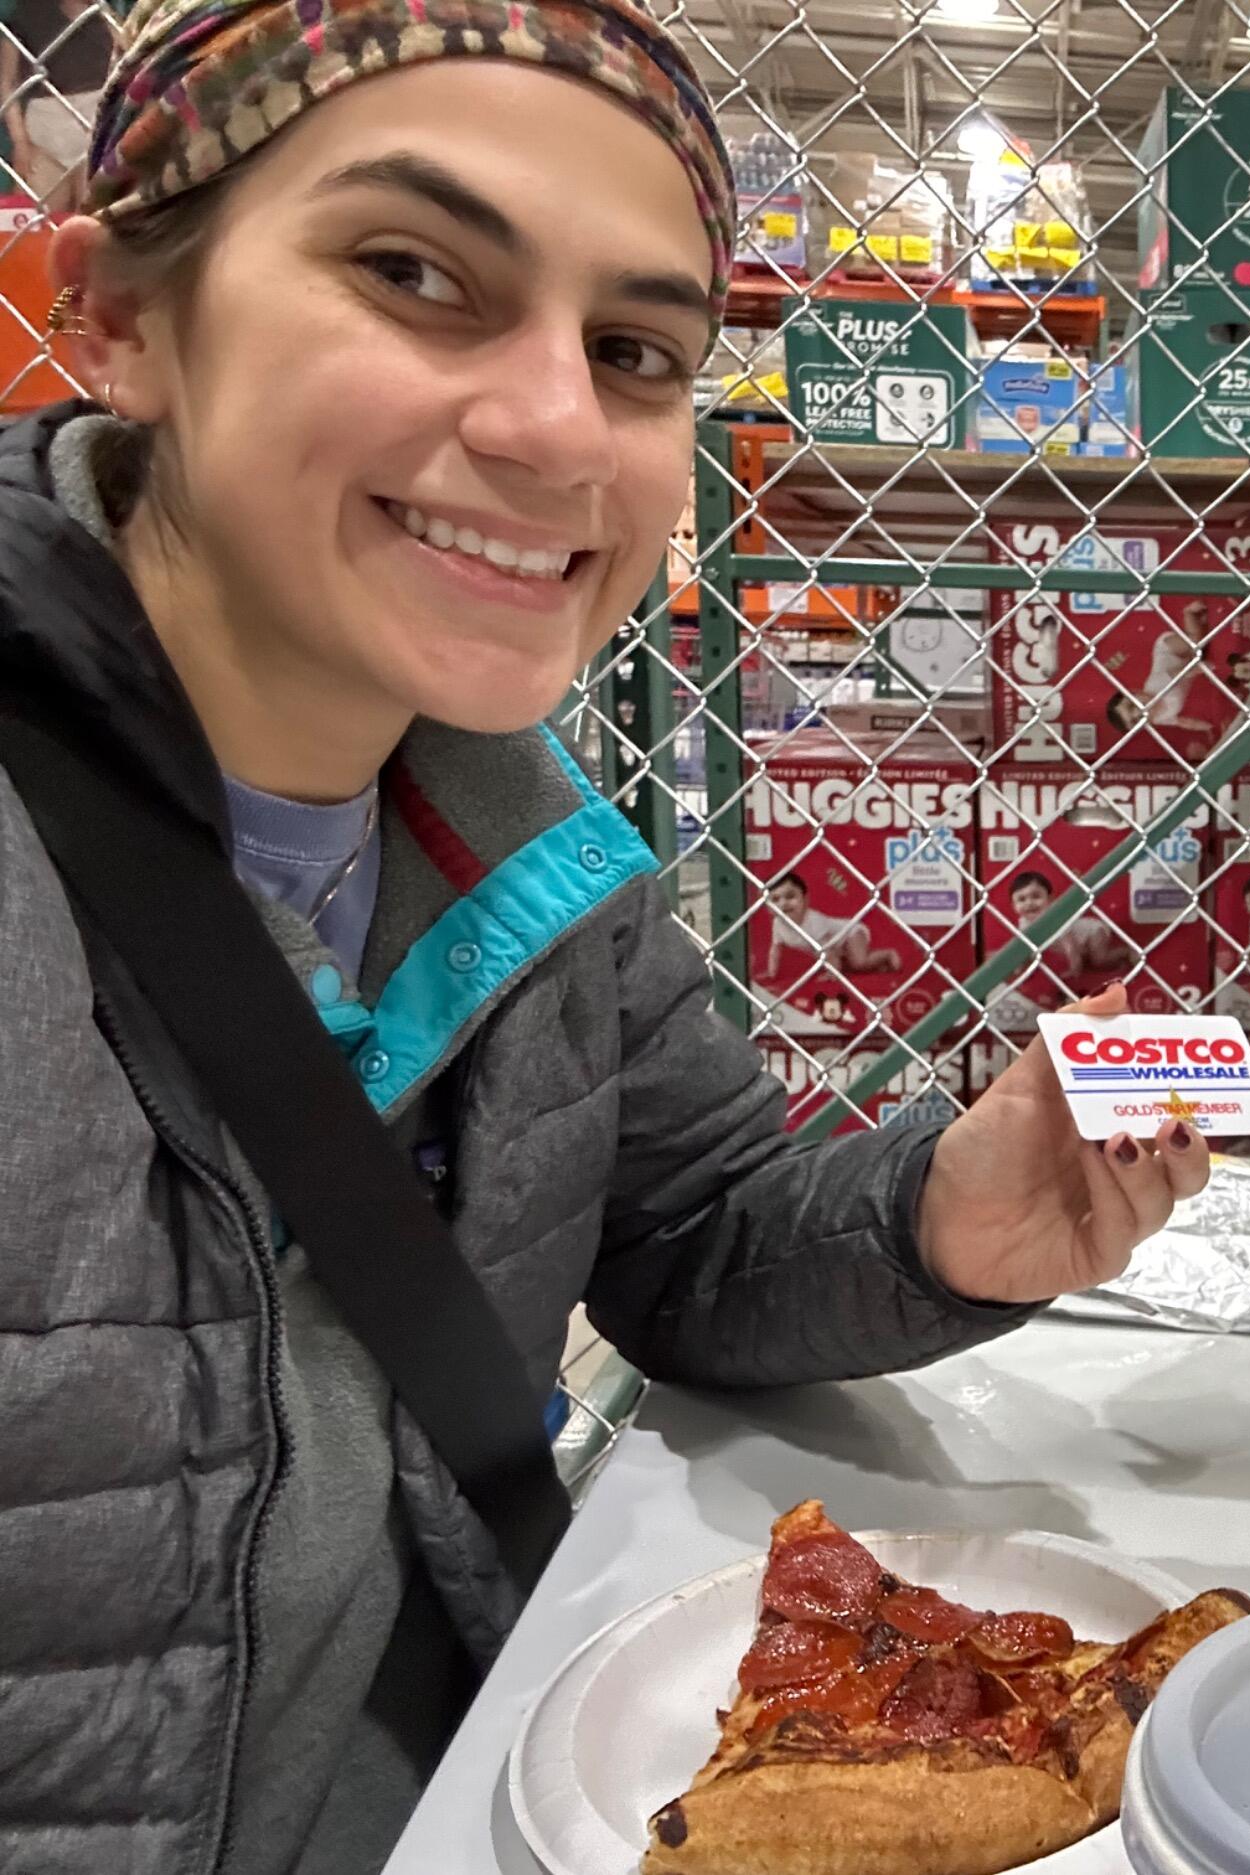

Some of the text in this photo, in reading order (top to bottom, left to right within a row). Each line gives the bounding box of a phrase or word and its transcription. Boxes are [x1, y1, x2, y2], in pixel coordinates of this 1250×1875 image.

[841, 407, 872, 420] FREE
[1060, 1032, 1246, 1065] COSTCO
[1130, 1066, 1250, 1080] WHOLESALE
